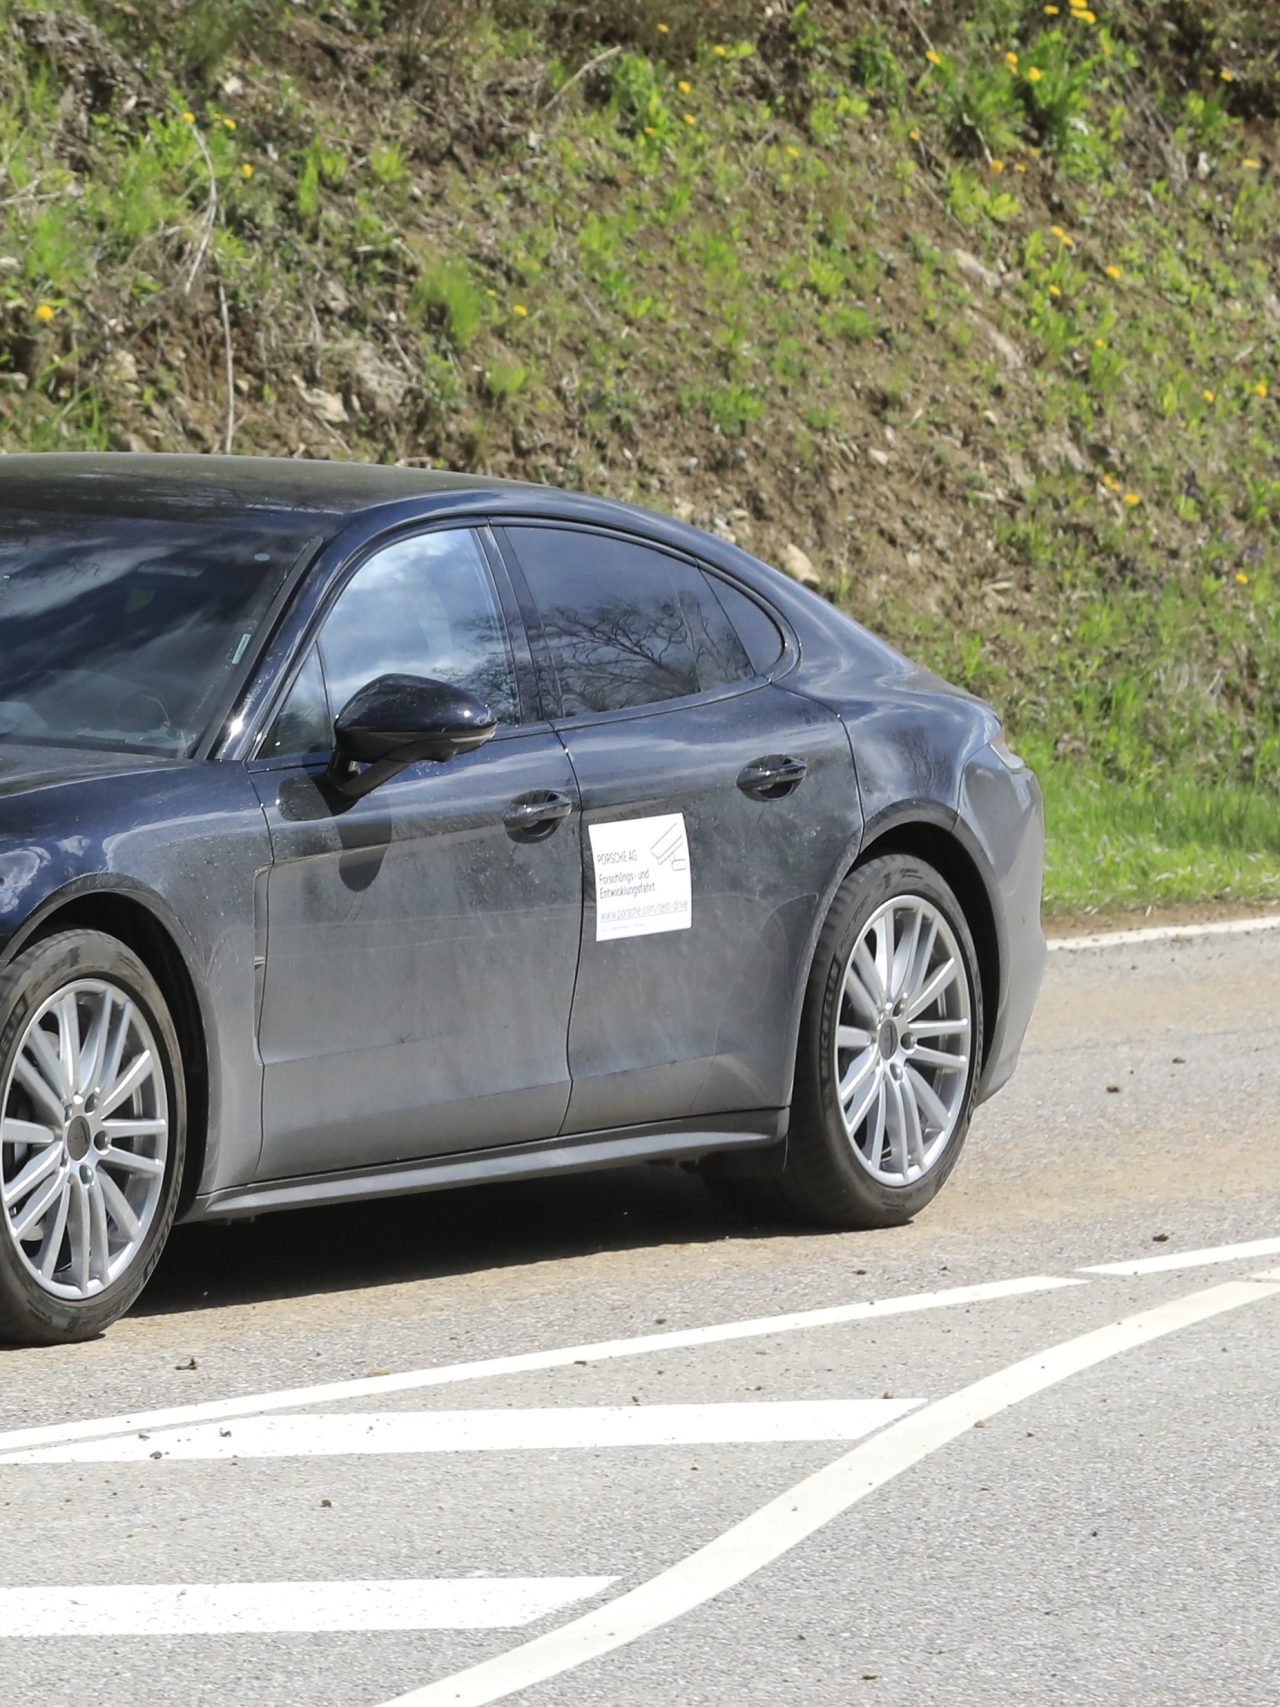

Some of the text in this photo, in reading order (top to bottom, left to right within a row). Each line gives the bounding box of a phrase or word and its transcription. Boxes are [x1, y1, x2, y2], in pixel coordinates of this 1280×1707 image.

[597, 849, 638, 865] PORSCHE AG
[637, 868, 650, 880] und
[600, 882, 656, 899] Entwicklungsfahrt
